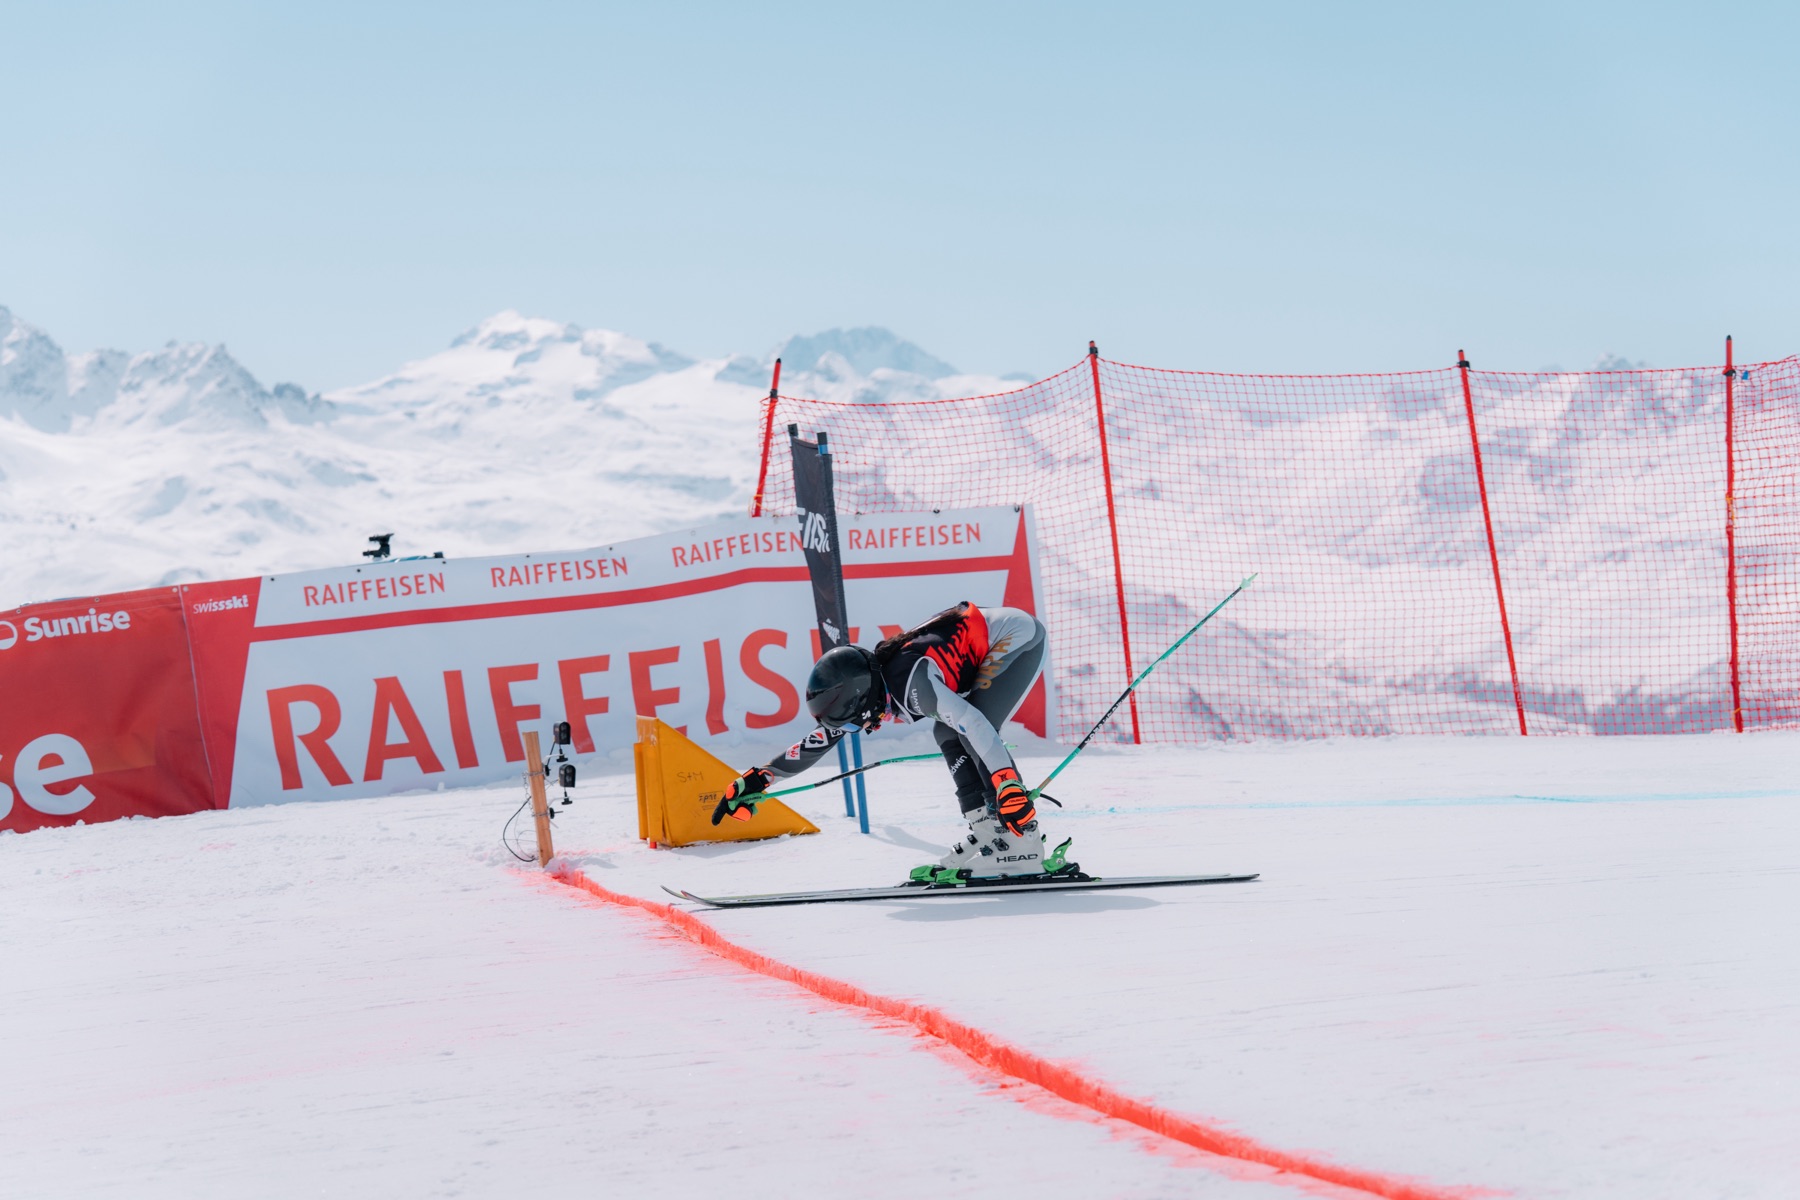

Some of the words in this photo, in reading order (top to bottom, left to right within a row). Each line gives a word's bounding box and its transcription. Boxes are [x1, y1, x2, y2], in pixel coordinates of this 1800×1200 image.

[672, 531, 804, 567] RAIFFEISEN
[849, 523, 981, 549] RAIFFEISEN
[491, 557, 628, 588] RAIFFEISEN
[303, 573, 446, 607] RAIFFEISEN
[24, 608, 131, 642] Sunrise
[266, 624, 906, 791] RAIFFEIS
[996, 853, 1039, 864] HEAD
